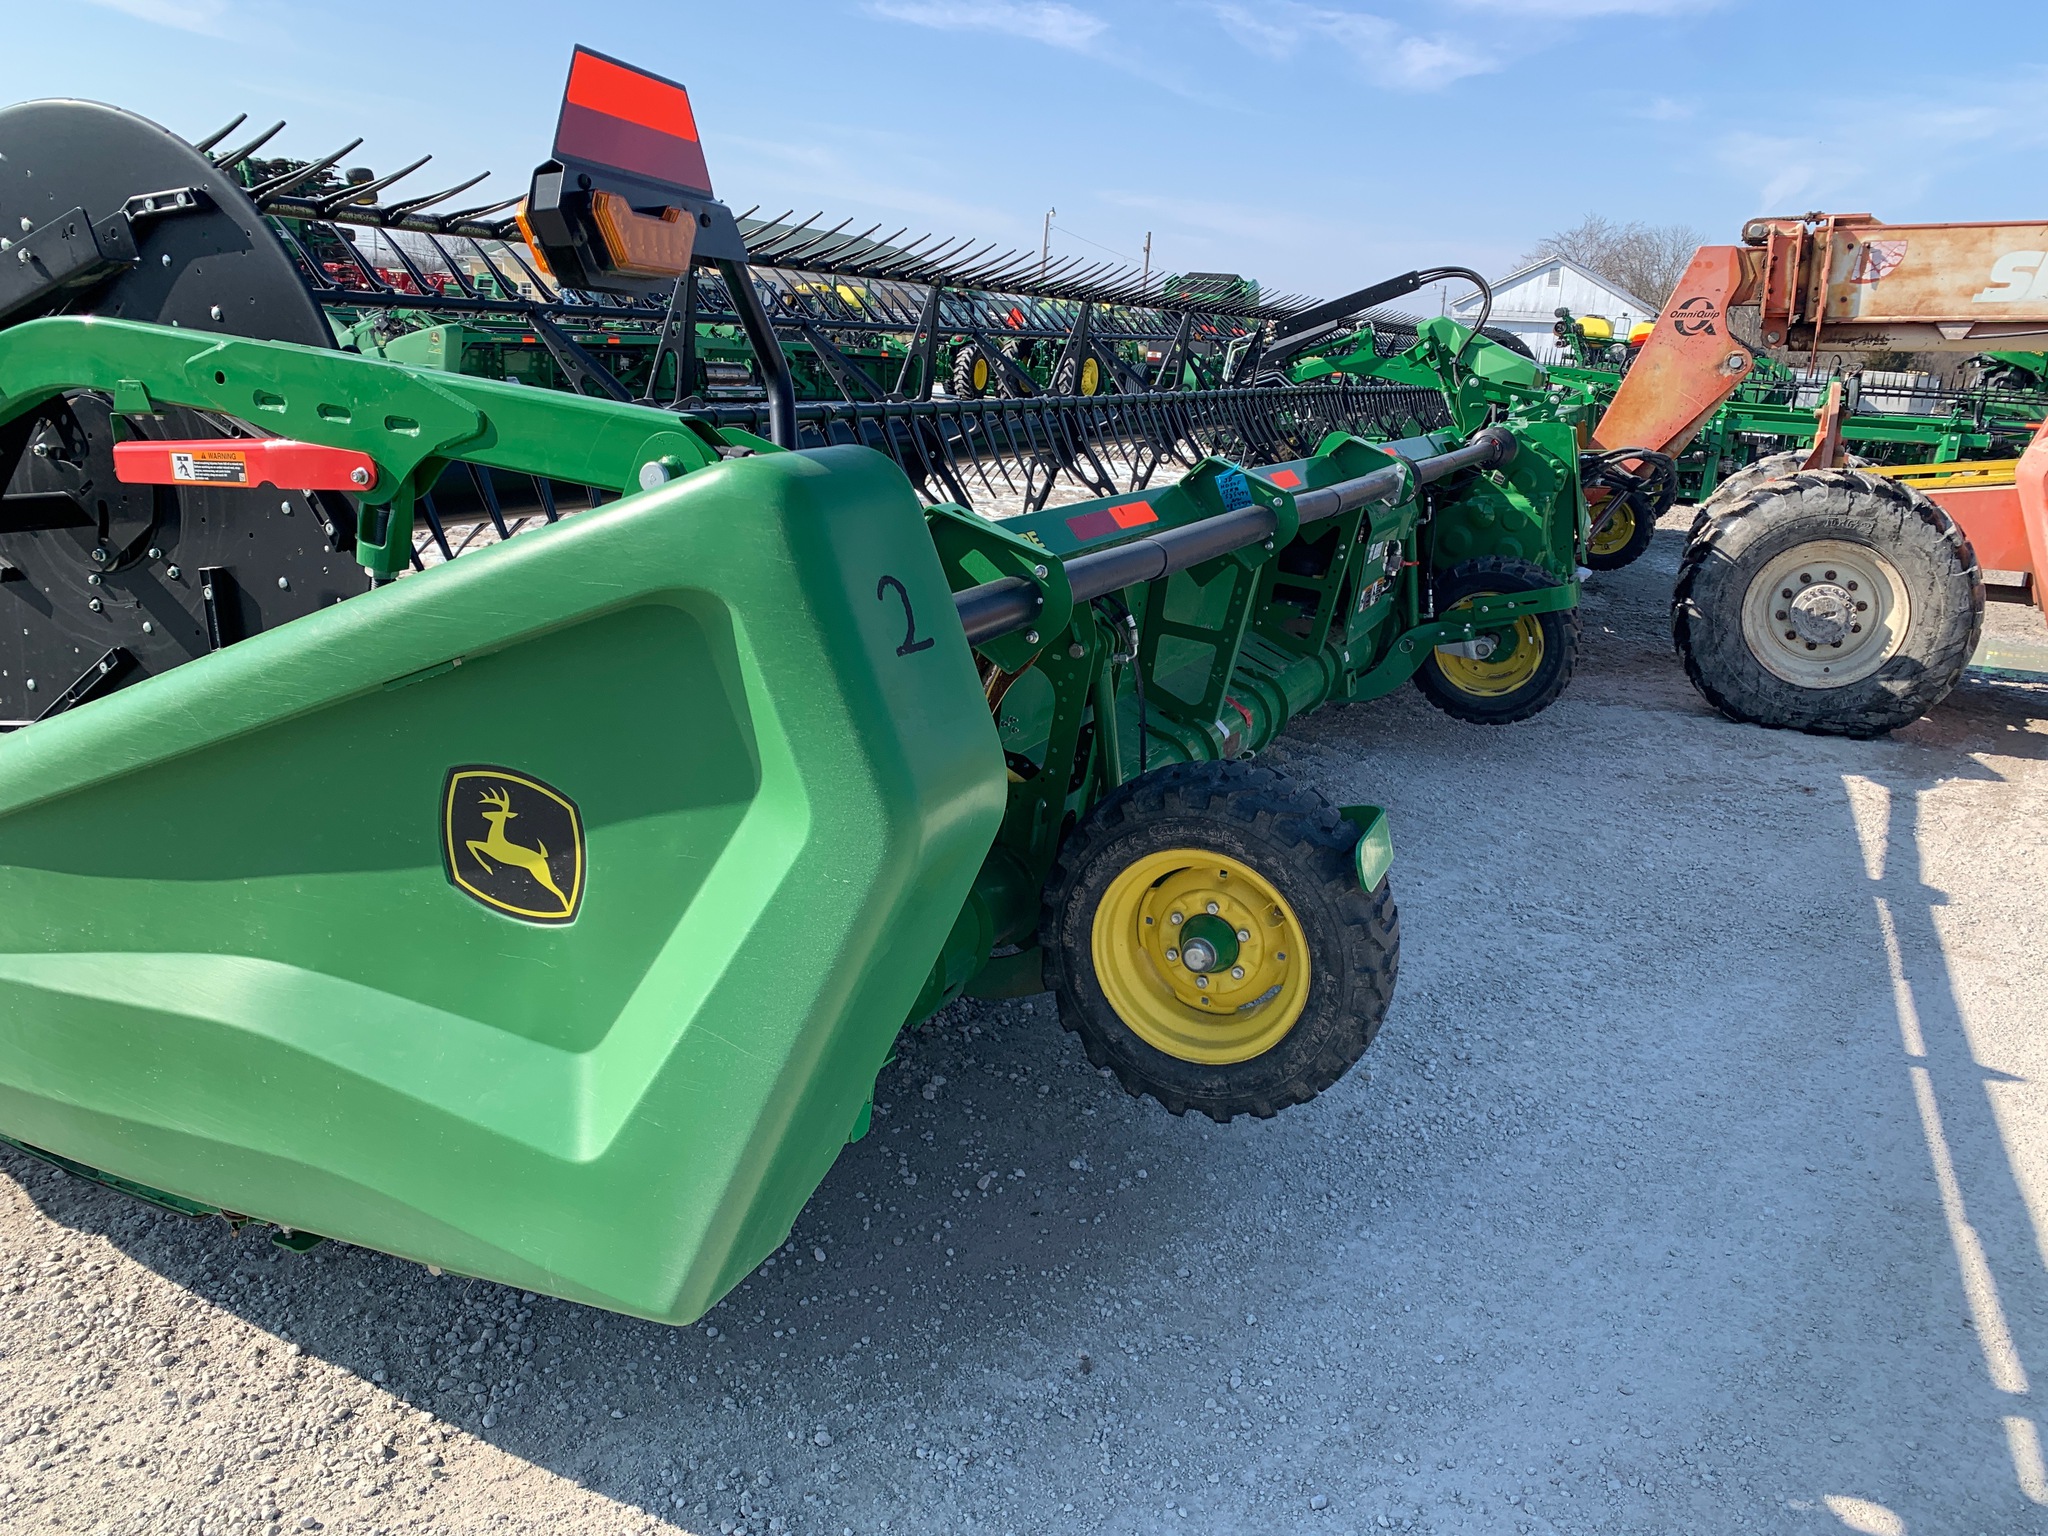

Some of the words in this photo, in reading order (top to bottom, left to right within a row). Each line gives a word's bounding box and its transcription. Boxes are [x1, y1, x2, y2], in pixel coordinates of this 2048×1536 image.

[1670, 310, 1720, 320] OmniQuip
[207, 452, 237, 460] WARNING
[877, 575, 935, 657] 2
